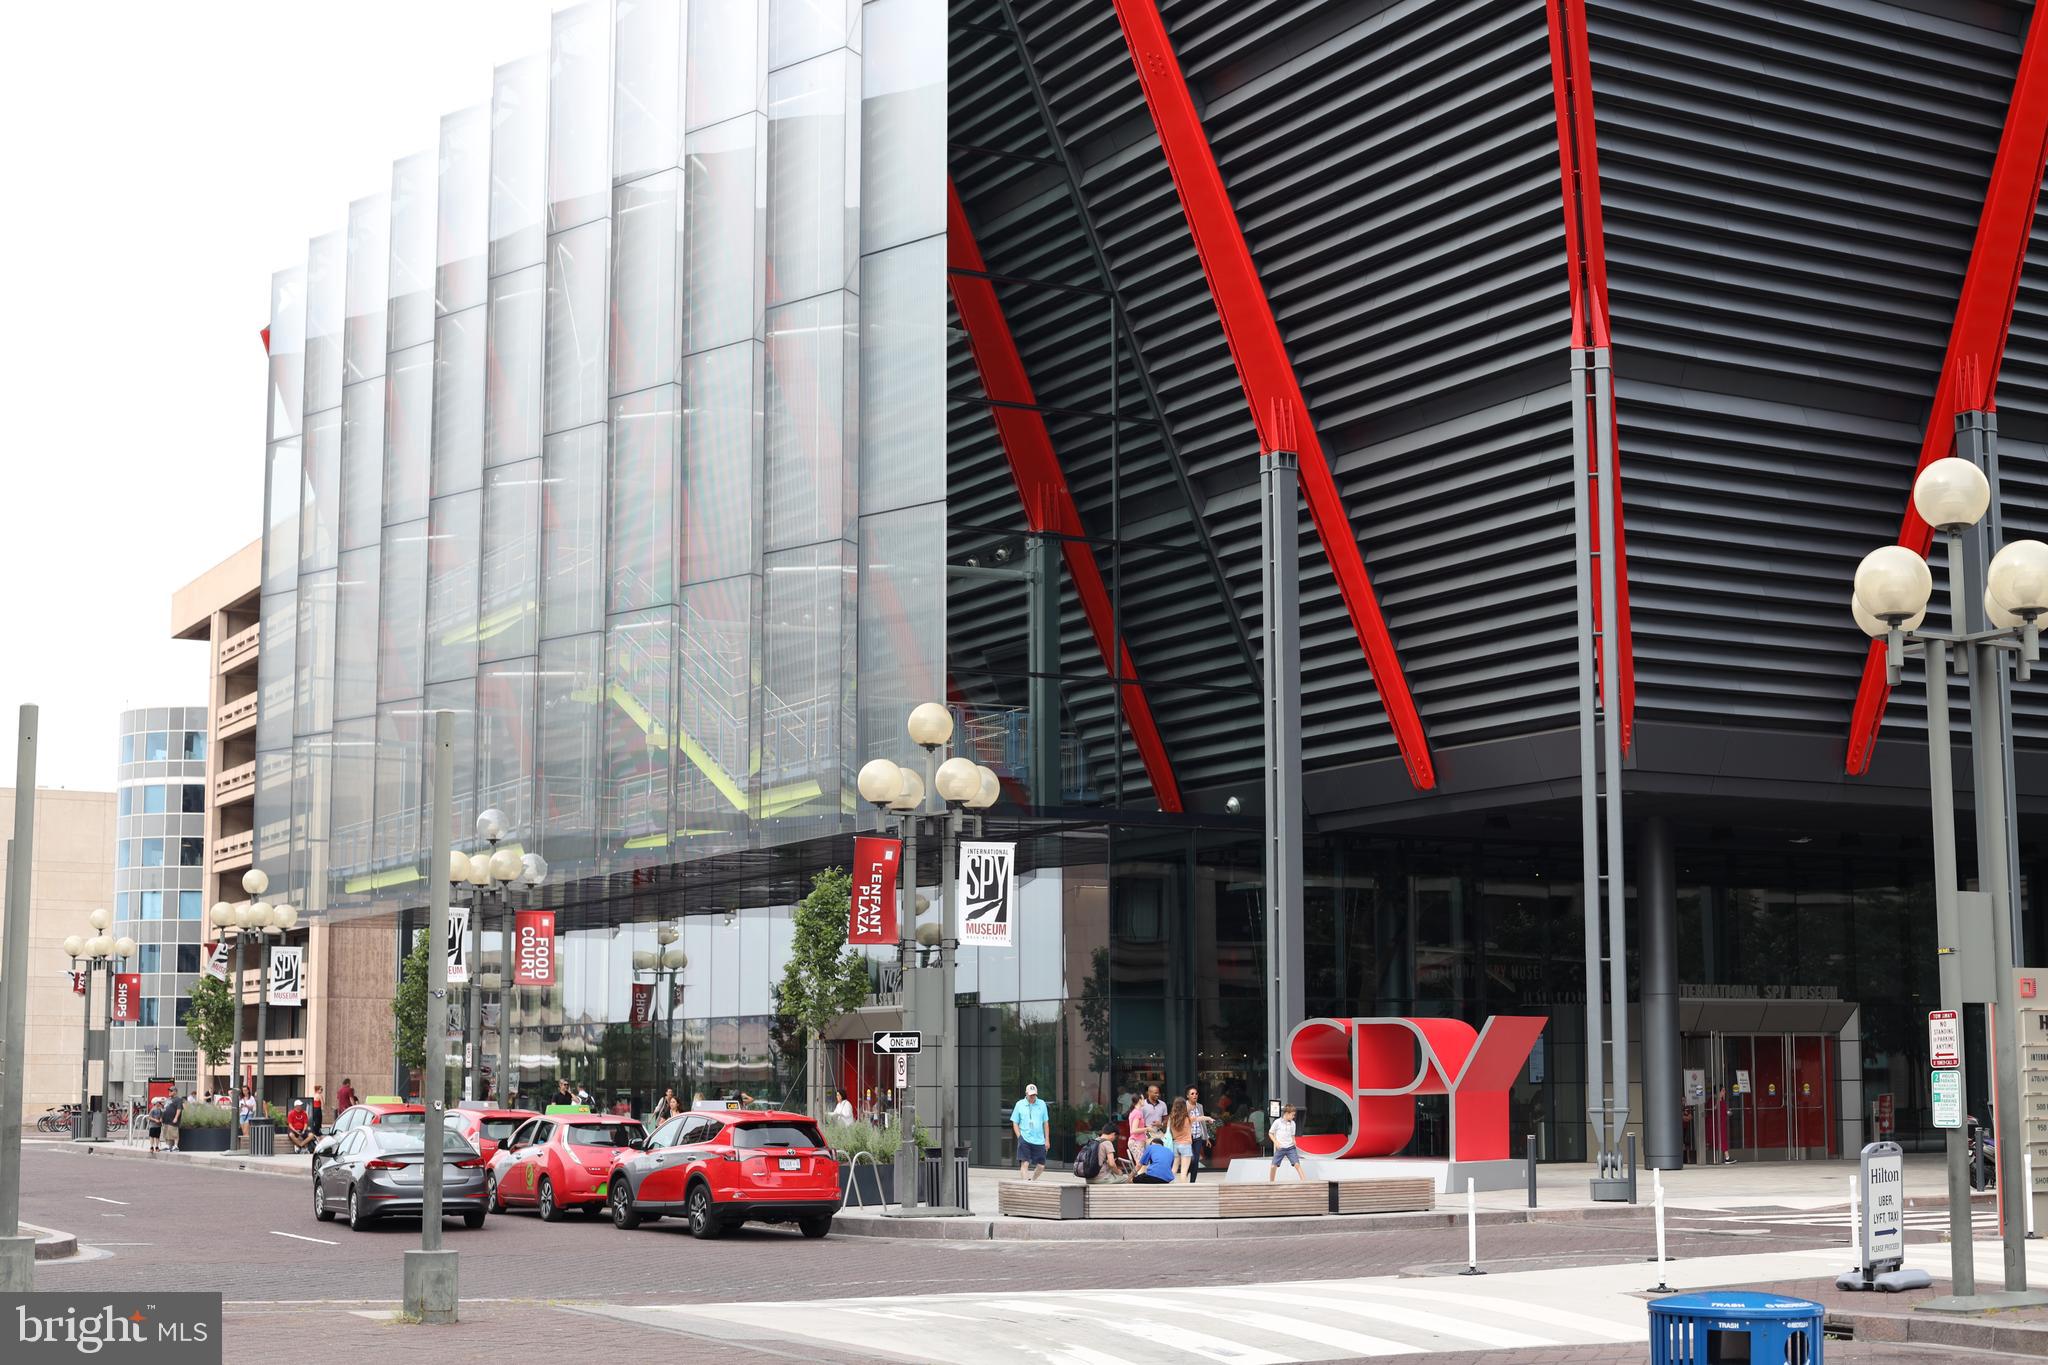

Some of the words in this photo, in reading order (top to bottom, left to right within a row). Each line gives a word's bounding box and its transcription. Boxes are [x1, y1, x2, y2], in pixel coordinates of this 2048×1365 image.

[967, 848, 1009, 856] INTERNATIONAL
[966, 856, 1009, 900] SPY
[869, 863, 883, 935] L'ENFANT
[856, 885, 870, 936] PLAZA
[965, 922, 1007, 936] MUSEUM
[520, 926, 536, 979] COURT
[535, 937, 549, 979] FOOD
[274, 953, 300, 981] SPY
[448, 966, 463, 975] EUM
[273, 992, 298, 1000] MUSEUM
[1766, 984, 1787, 1000] SPY
[1790, 985, 1838, 1000] MUSEUM
[117, 983, 128, 1017] SHOPS
[890, 1038, 904, 1047] ONE
[905, 1038, 917, 1047] WAY
[1934, 1073, 1939, 1082] 2
[1286, 1015, 1530, 1163] SPY
[2036, 1103, 2046, 1111] 500
[2037, 1124, 2047, 1132] 950
[2038, 1149, 2048, 1157] 955
[1871, 1167, 1899, 1184] Hilton
[1888, 1210, 1899, 1222] TAXI
[1871, 1244, 1884, 1253] PLEASE
[1884, 1242, 1900, 1251] PROCEED
[1718, 1321, 1740, 1329] TRASH
